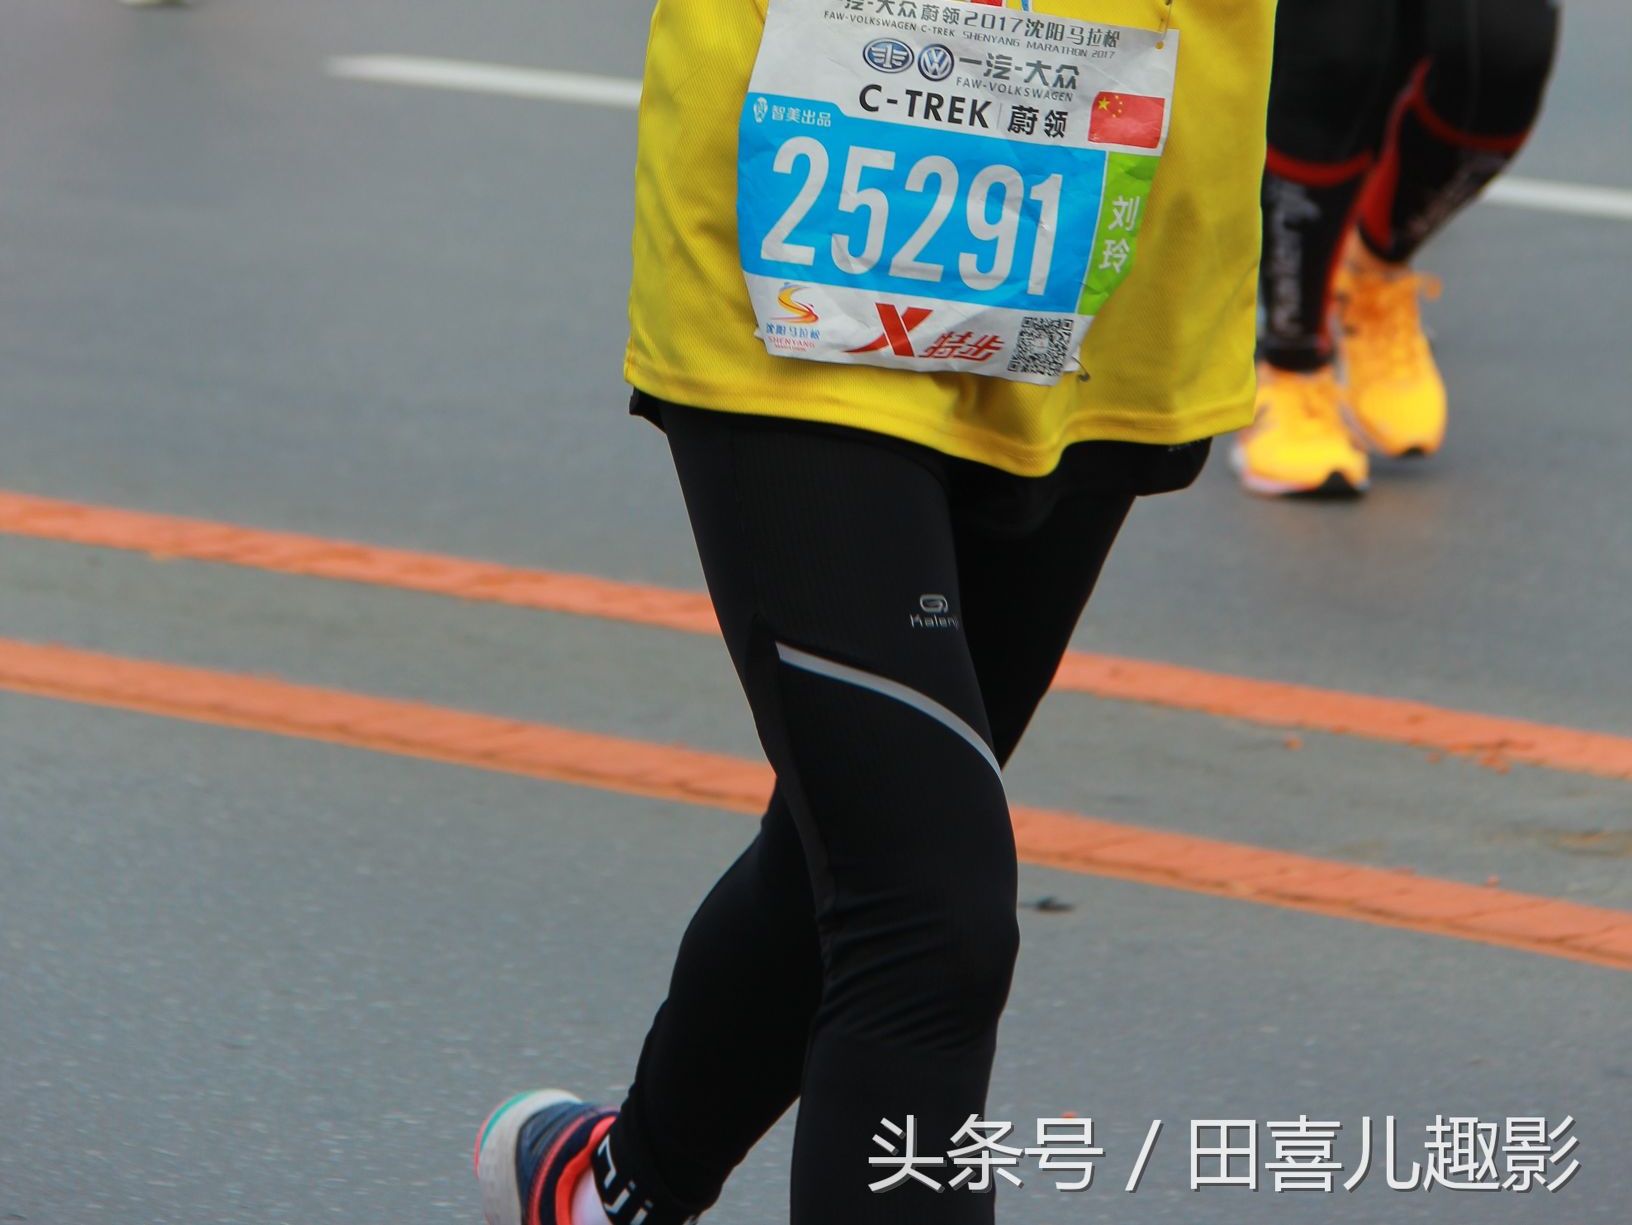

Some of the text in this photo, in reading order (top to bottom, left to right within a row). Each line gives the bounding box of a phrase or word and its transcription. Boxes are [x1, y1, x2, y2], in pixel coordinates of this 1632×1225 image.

[823, 10, 917, 32] FAW-VOLKSWAGEN
[920, 24, 956, 38] C-TREK
[962, 30, 1021, 48] SHENYANG
[858, 83, 1069, 139] C-TREK 蔚领
[955, 76, 1074, 103] FAW-VOLKSWAGEN
[760, 135, 1063, 297] 25291
[1098, 194, 1141, 275] 刘玲
